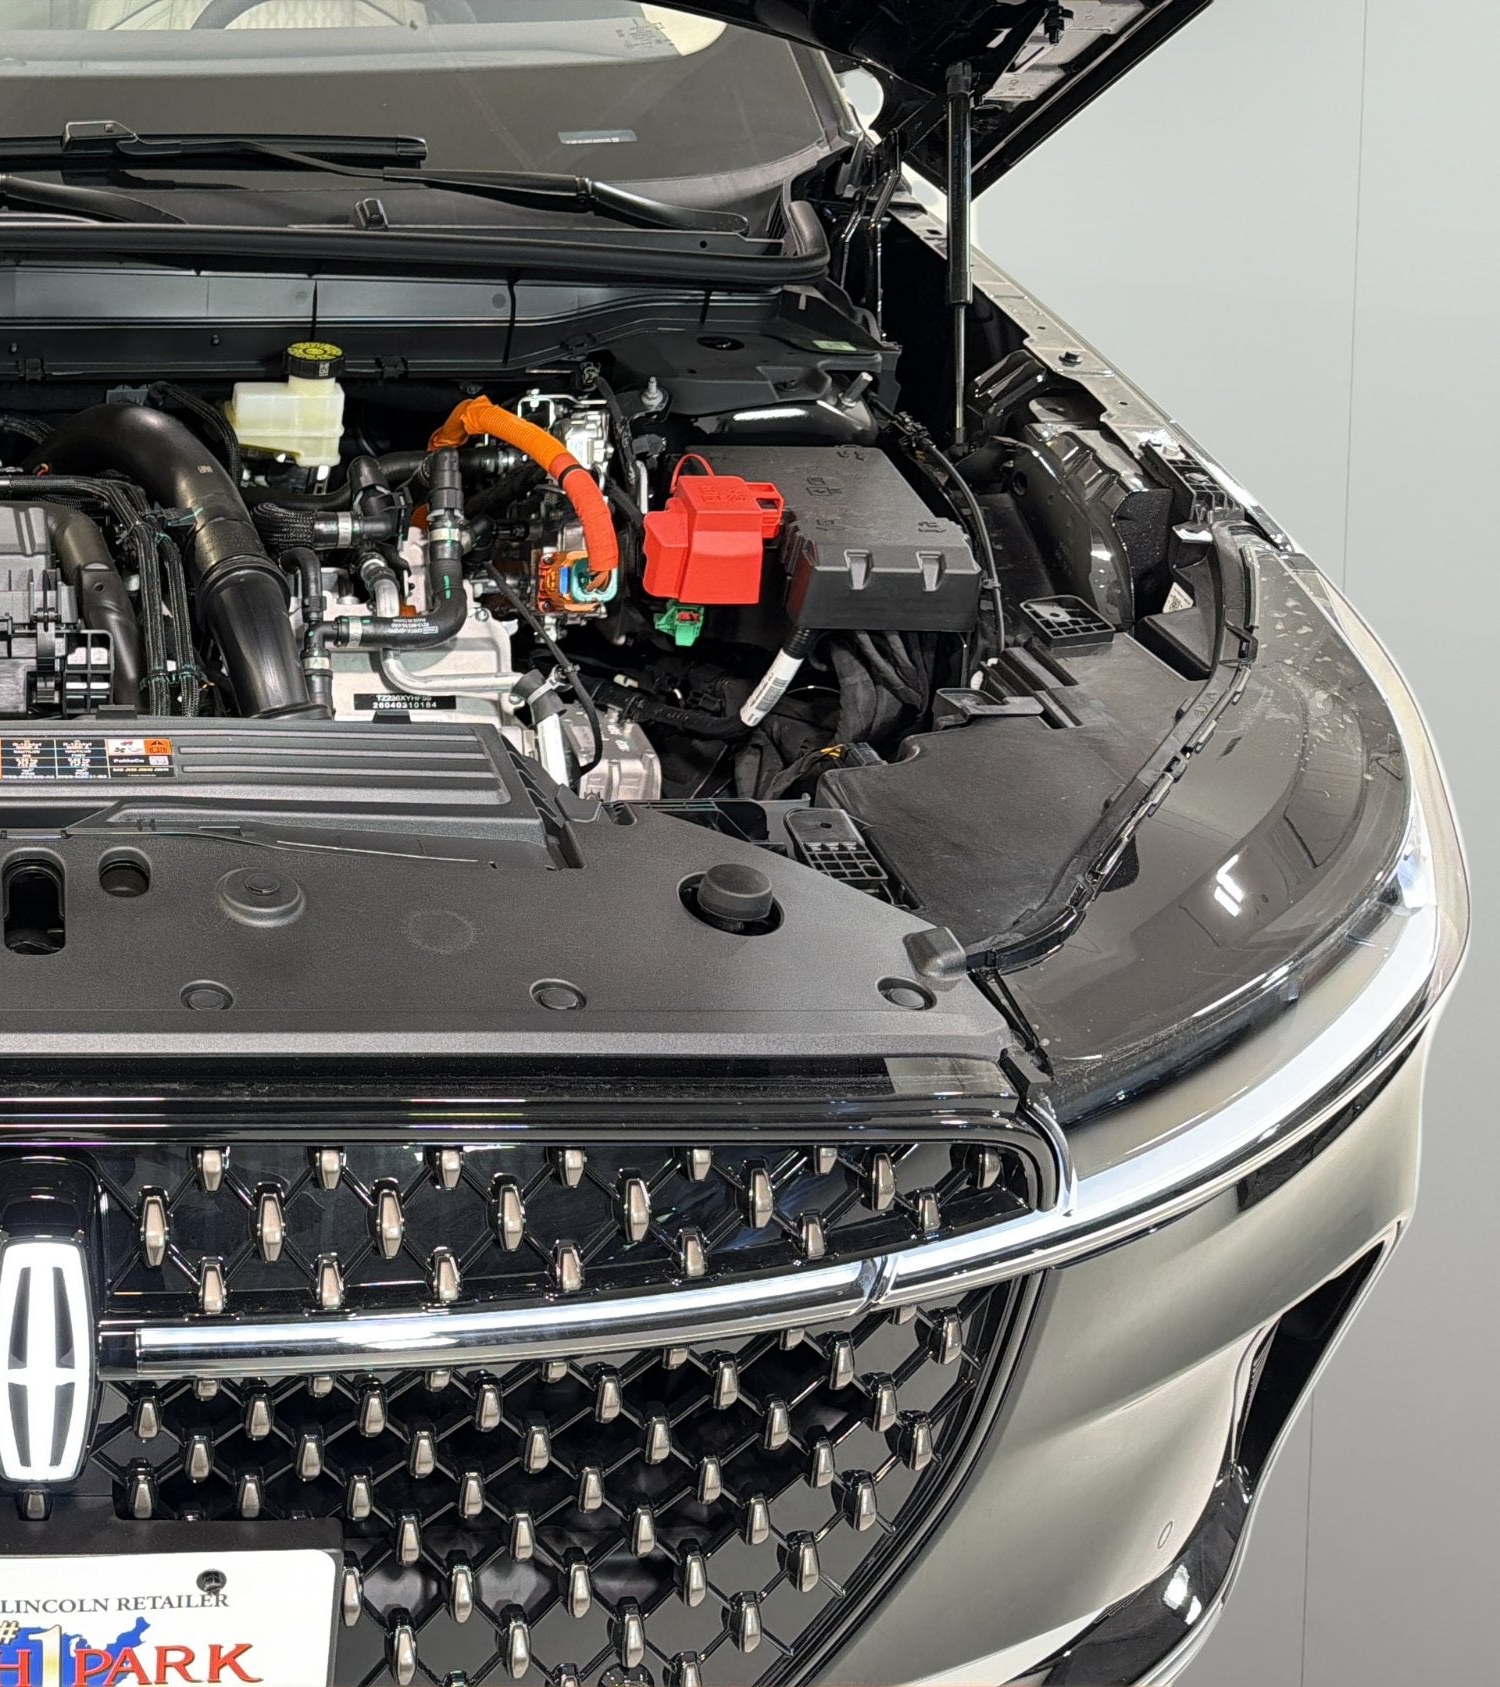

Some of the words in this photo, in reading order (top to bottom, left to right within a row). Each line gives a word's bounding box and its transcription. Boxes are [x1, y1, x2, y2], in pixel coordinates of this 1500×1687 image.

[0, 1598, 109, 1614] LINCOLN
[116, 1593, 230, 1612] RETAILER
[72, 1642, 265, 1687] PARK
